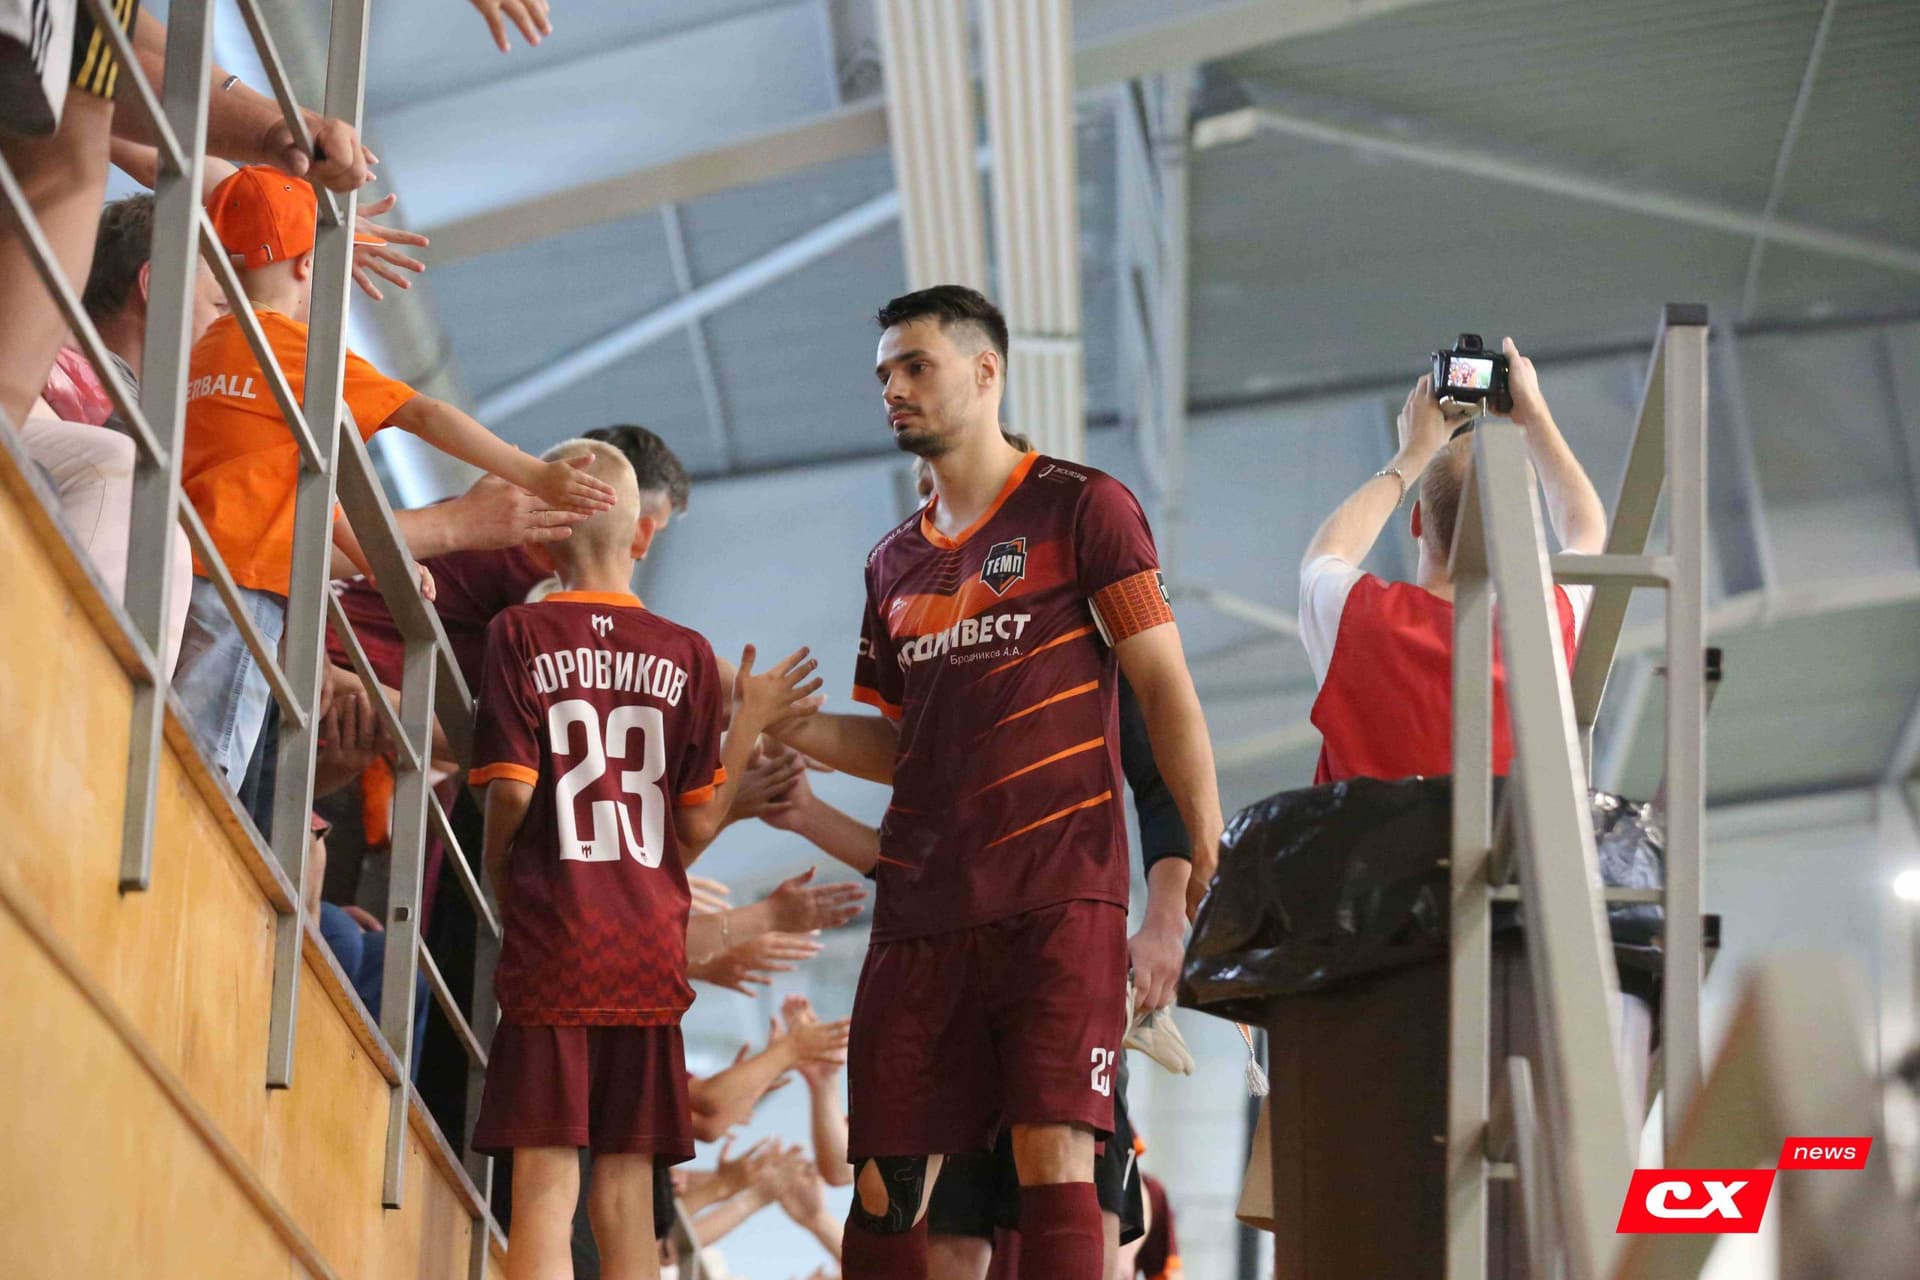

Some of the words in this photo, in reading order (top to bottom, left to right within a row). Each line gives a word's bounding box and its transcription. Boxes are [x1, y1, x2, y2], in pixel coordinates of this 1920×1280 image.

[986, 554, 1023, 577] ТЕМП
[950, 650, 1000, 666] Бродников
[548, 699, 666, 869] 23
